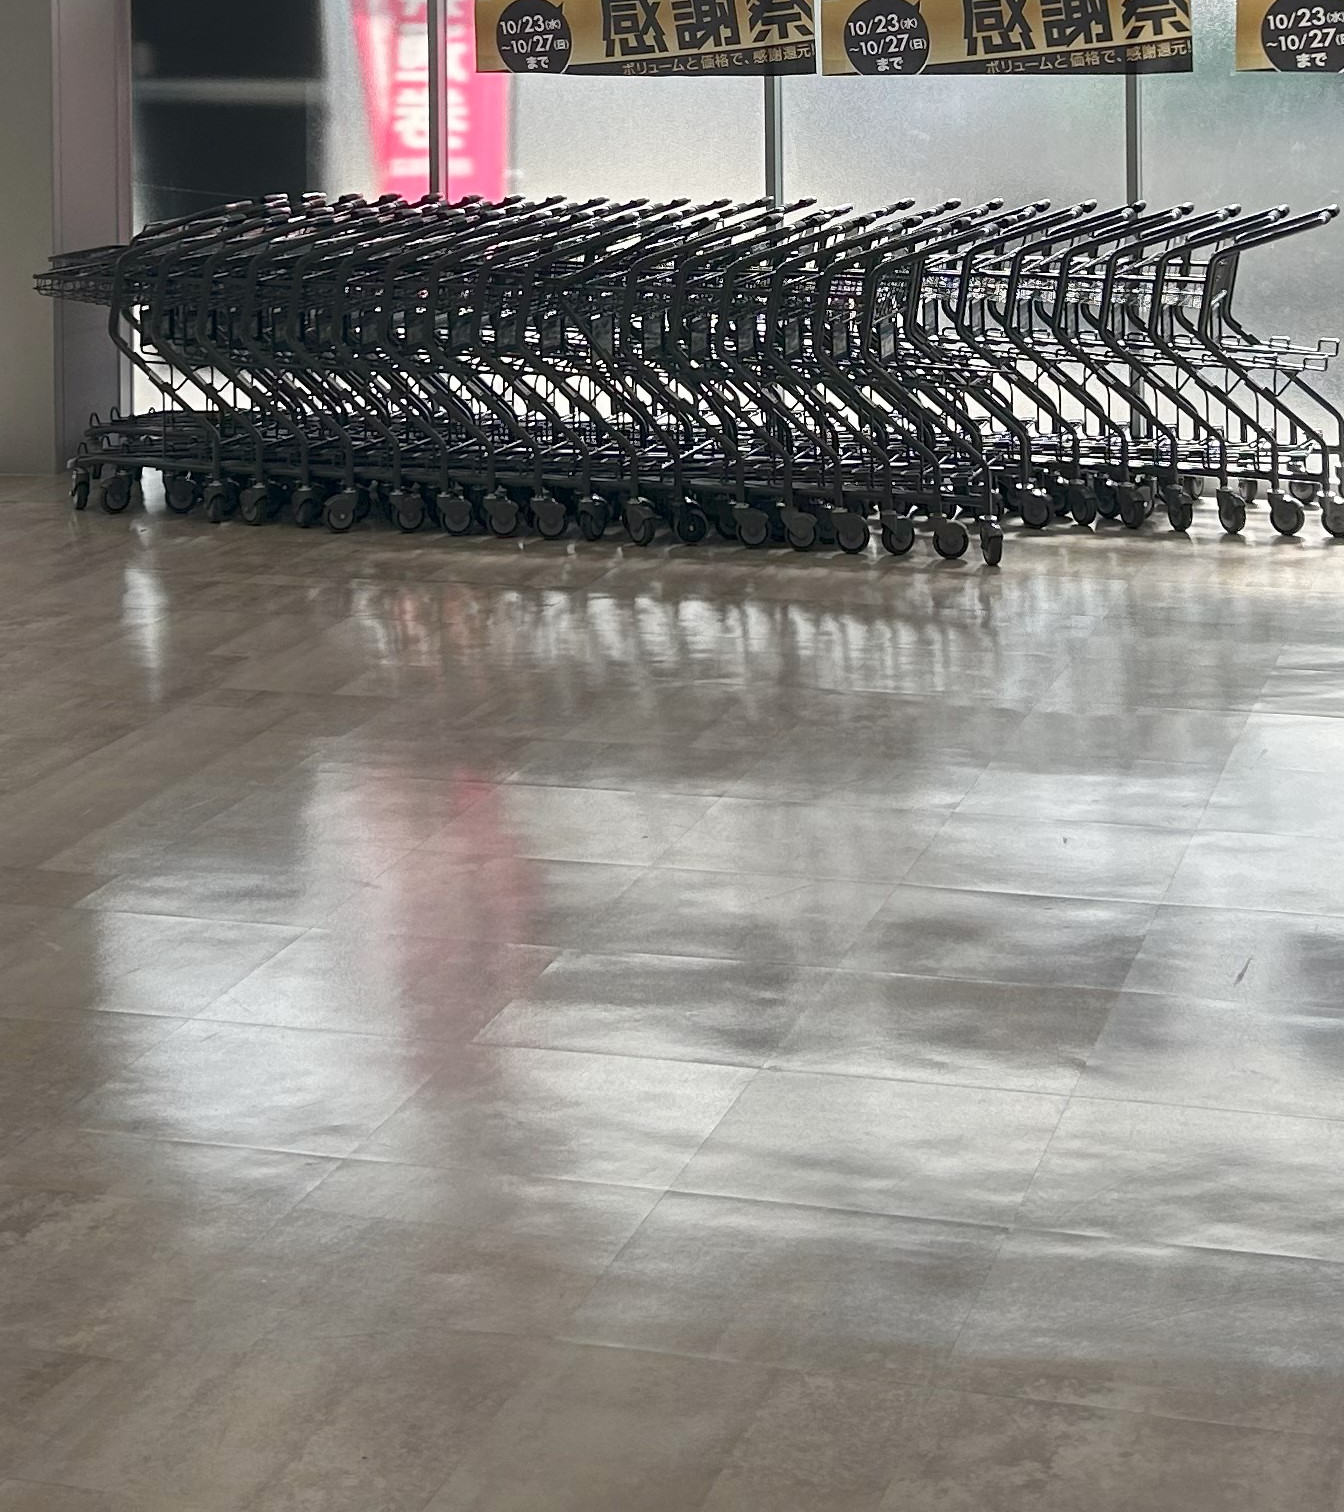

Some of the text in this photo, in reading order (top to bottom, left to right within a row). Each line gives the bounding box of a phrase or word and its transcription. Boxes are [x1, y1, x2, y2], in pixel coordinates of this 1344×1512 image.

[526, 56, 550, 70] まで
[875, 56, 904, 72] まで
[1296, 54, 1328, 69] まで
